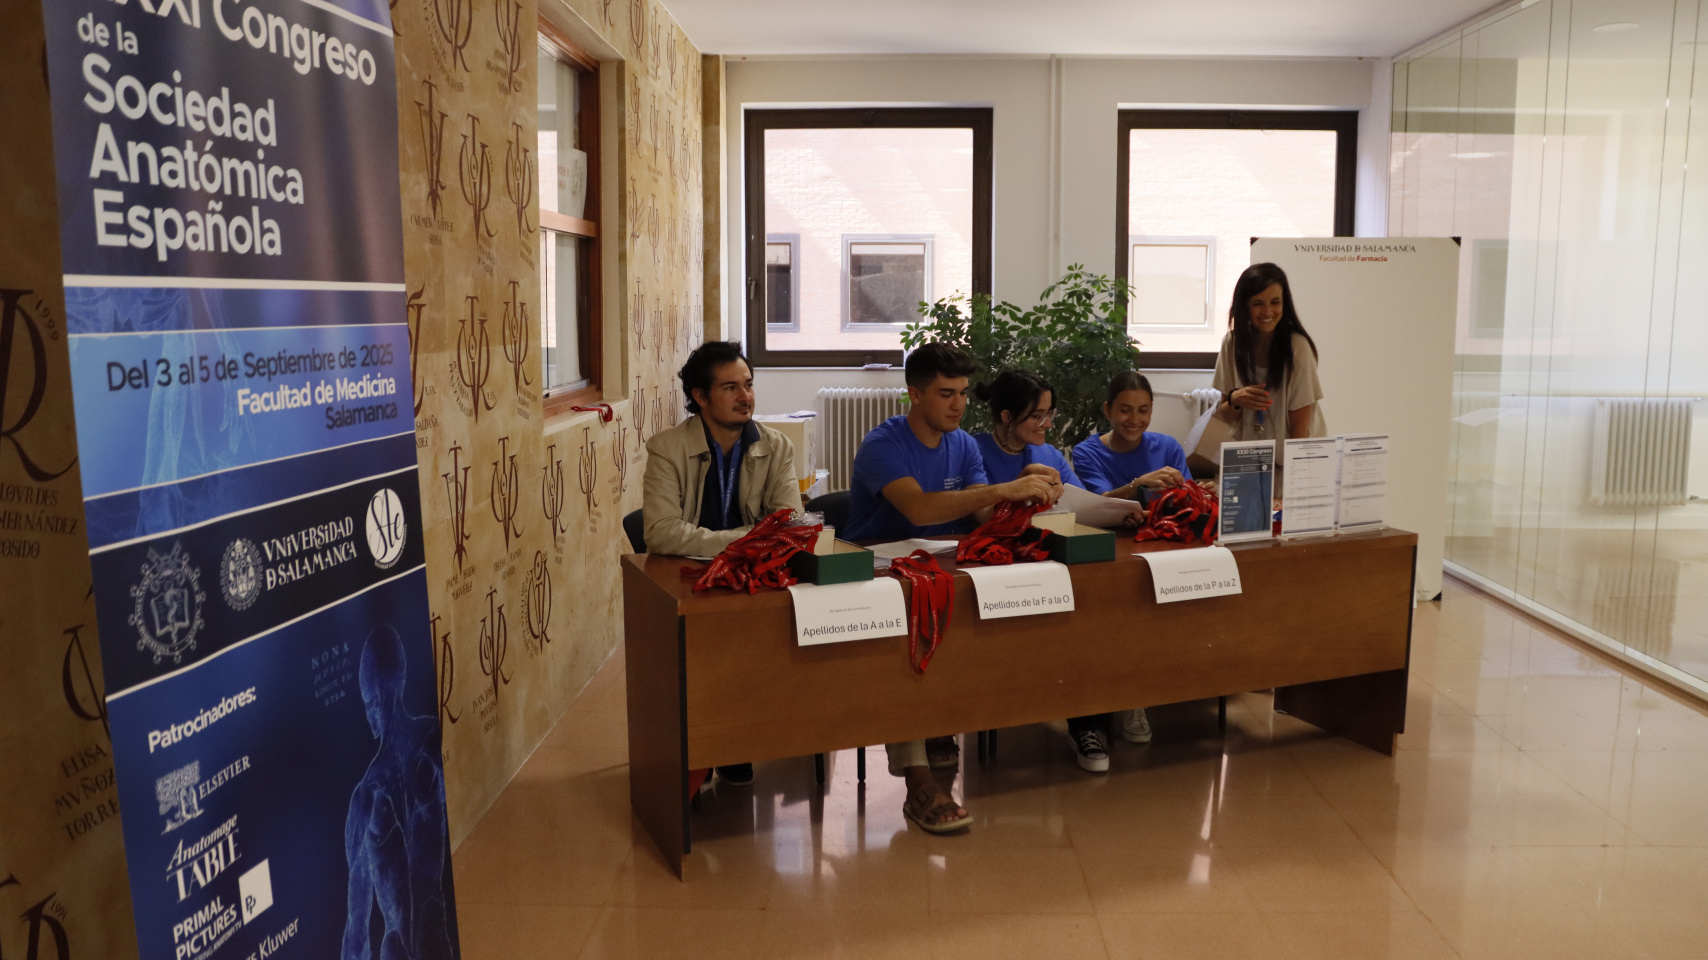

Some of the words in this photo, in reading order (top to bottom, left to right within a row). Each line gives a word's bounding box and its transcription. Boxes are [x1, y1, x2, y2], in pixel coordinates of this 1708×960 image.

[77, 13, 110, 47] de
[116, 21, 139, 55] la
[212, 0, 377, 85] Congreso
[82, 52, 277, 146] Sociedad
[89, 123, 304, 204] Anatómica
[92, 189, 282, 262] Española
[1319, 254, 1346, 262] Facultad
[1347, 254, 1355, 262] de
[1356, 254, 1388, 262] Farmacia
[1363, 244, 1416, 253] SALAMANCA
[107, 358, 149, 391] Del
[156, 357, 173, 387] 3
[178, 357, 195, 385] al
[199, 355, 211, 383] 5
[214, 353, 239, 381] de
[243, 347, 336, 382] Septiembre
[338, 346, 357, 370] de
[360, 344, 394, 367] 2025
[237, 378, 312, 416] Facultad
[314, 379, 334, 404] de
[336, 373, 396, 402] Medicina
[325, 401, 397, 430] Salamanca
[277, 540, 358, 586] SALAMANCA
[983, 601, 1021, 612] Apellidos
[1021, 598, 1032, 607] de
[1032, 597, 1041, 606] la
[1041, 596, 1047, 605] F
[1048, 597, 1053, 605] a
[1054, 595, 1062, 604] la
[1062, 594, 1070, 604] O
[1160, 585, 1193, 596] Apellidos
[1194, 583, 1203, 591] de
[1204, 582, 1211, 590] la
[1212, 580, 1217, 589] P
[1223, 579, 1231, 587] la
[1231, 578, 1237, 587] Z
[803, 625, 846, 638] Apellidos
[847, 623, 859, 632] de
[860, 622, 869, 631] la
[870, 620, 877, 630] A
[878, 621, 884, 629] a
[885, 619, 894, 628] la
[895, 618, 902, 627] E
[311, 642, 349, 670] NONA
[148, 686, 257, 754] Patrocinadores:
[199, 755, 251, 800] ELSEVIER
[166, 814, 238, 872] Anatomage
[166, 828, 242, 904] TABLE
[173, 896, 225, 944] PRIMAL
[176, 904, 238, 960] PICTURES
[258, 917, 299, 960] Kluwer
